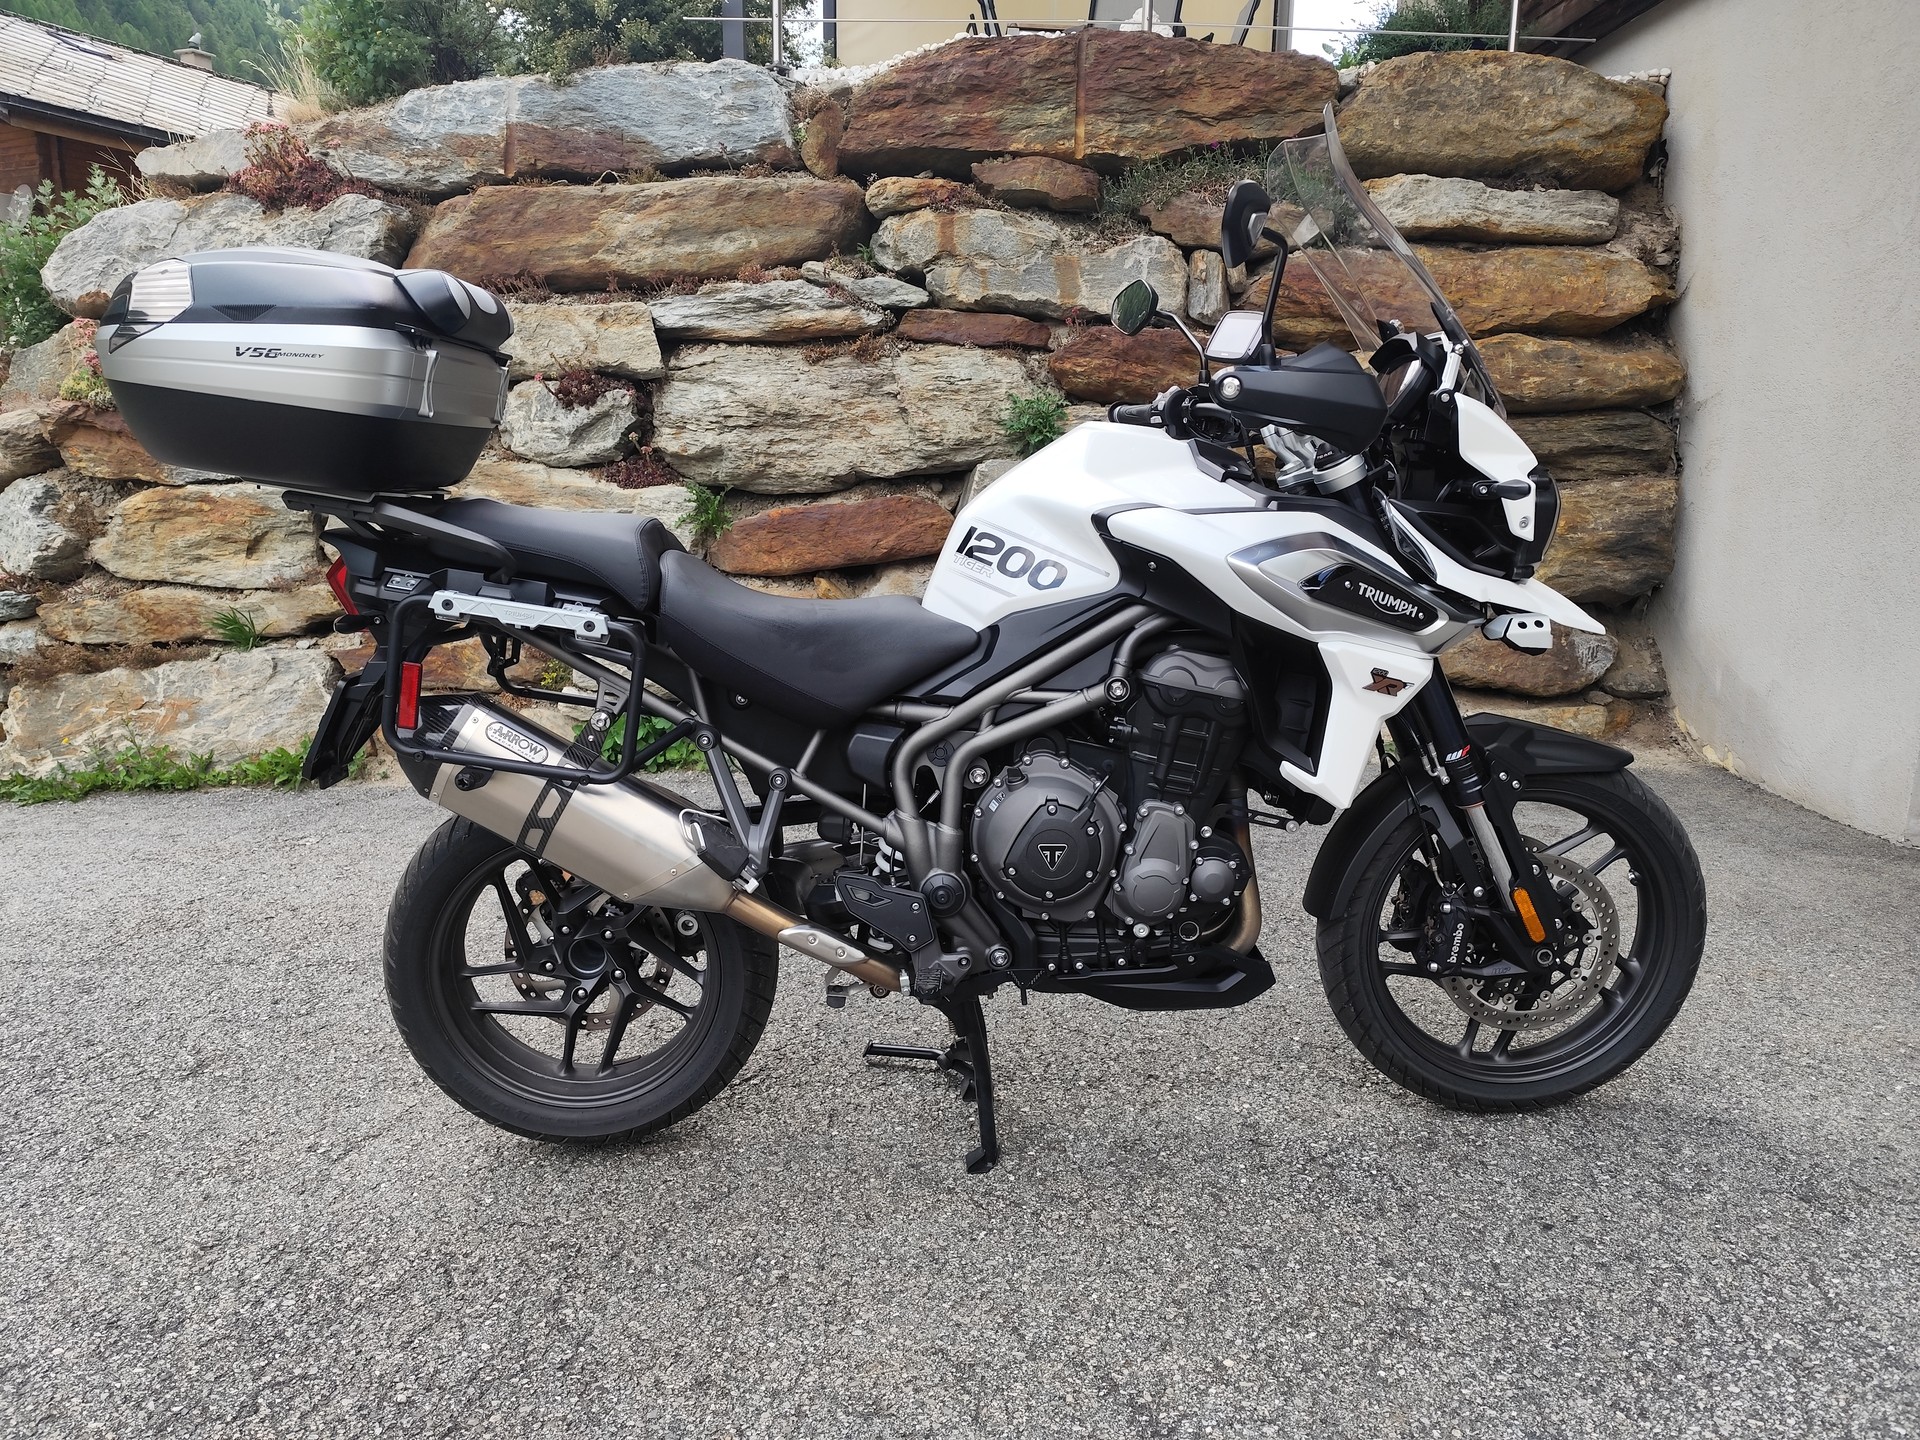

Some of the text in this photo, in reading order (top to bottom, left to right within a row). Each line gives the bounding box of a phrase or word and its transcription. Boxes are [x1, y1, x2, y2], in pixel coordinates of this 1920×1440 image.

[235, 346, 282, 358] V56
[953, 553, 995, 578] TIGER
[956, 525, 1068, 591] 1200
[1358, 582, 1418, 618] TRIUMPH
[492, 726, 543, 756] ARROW
[1446, 923, 1465, 964] brembo
